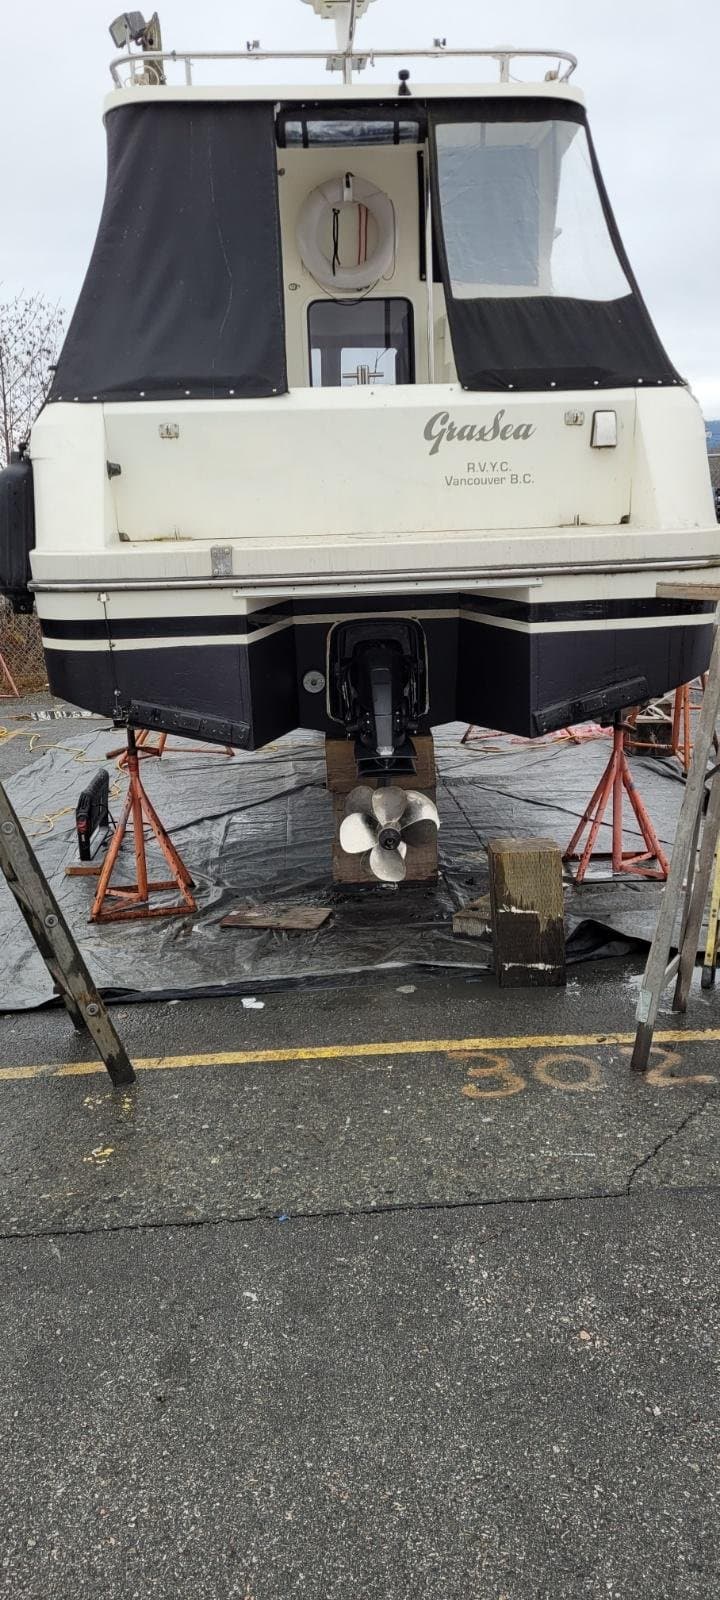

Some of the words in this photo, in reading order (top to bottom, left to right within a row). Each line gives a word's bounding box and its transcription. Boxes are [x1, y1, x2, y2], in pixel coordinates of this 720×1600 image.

[466, 461, 512, 473] R.V.Y.C.
[445, 475, 506, 486] Vancouver
[510, 474, 535, 485] B.C.
[447, 1046, 718, 1099] 302
